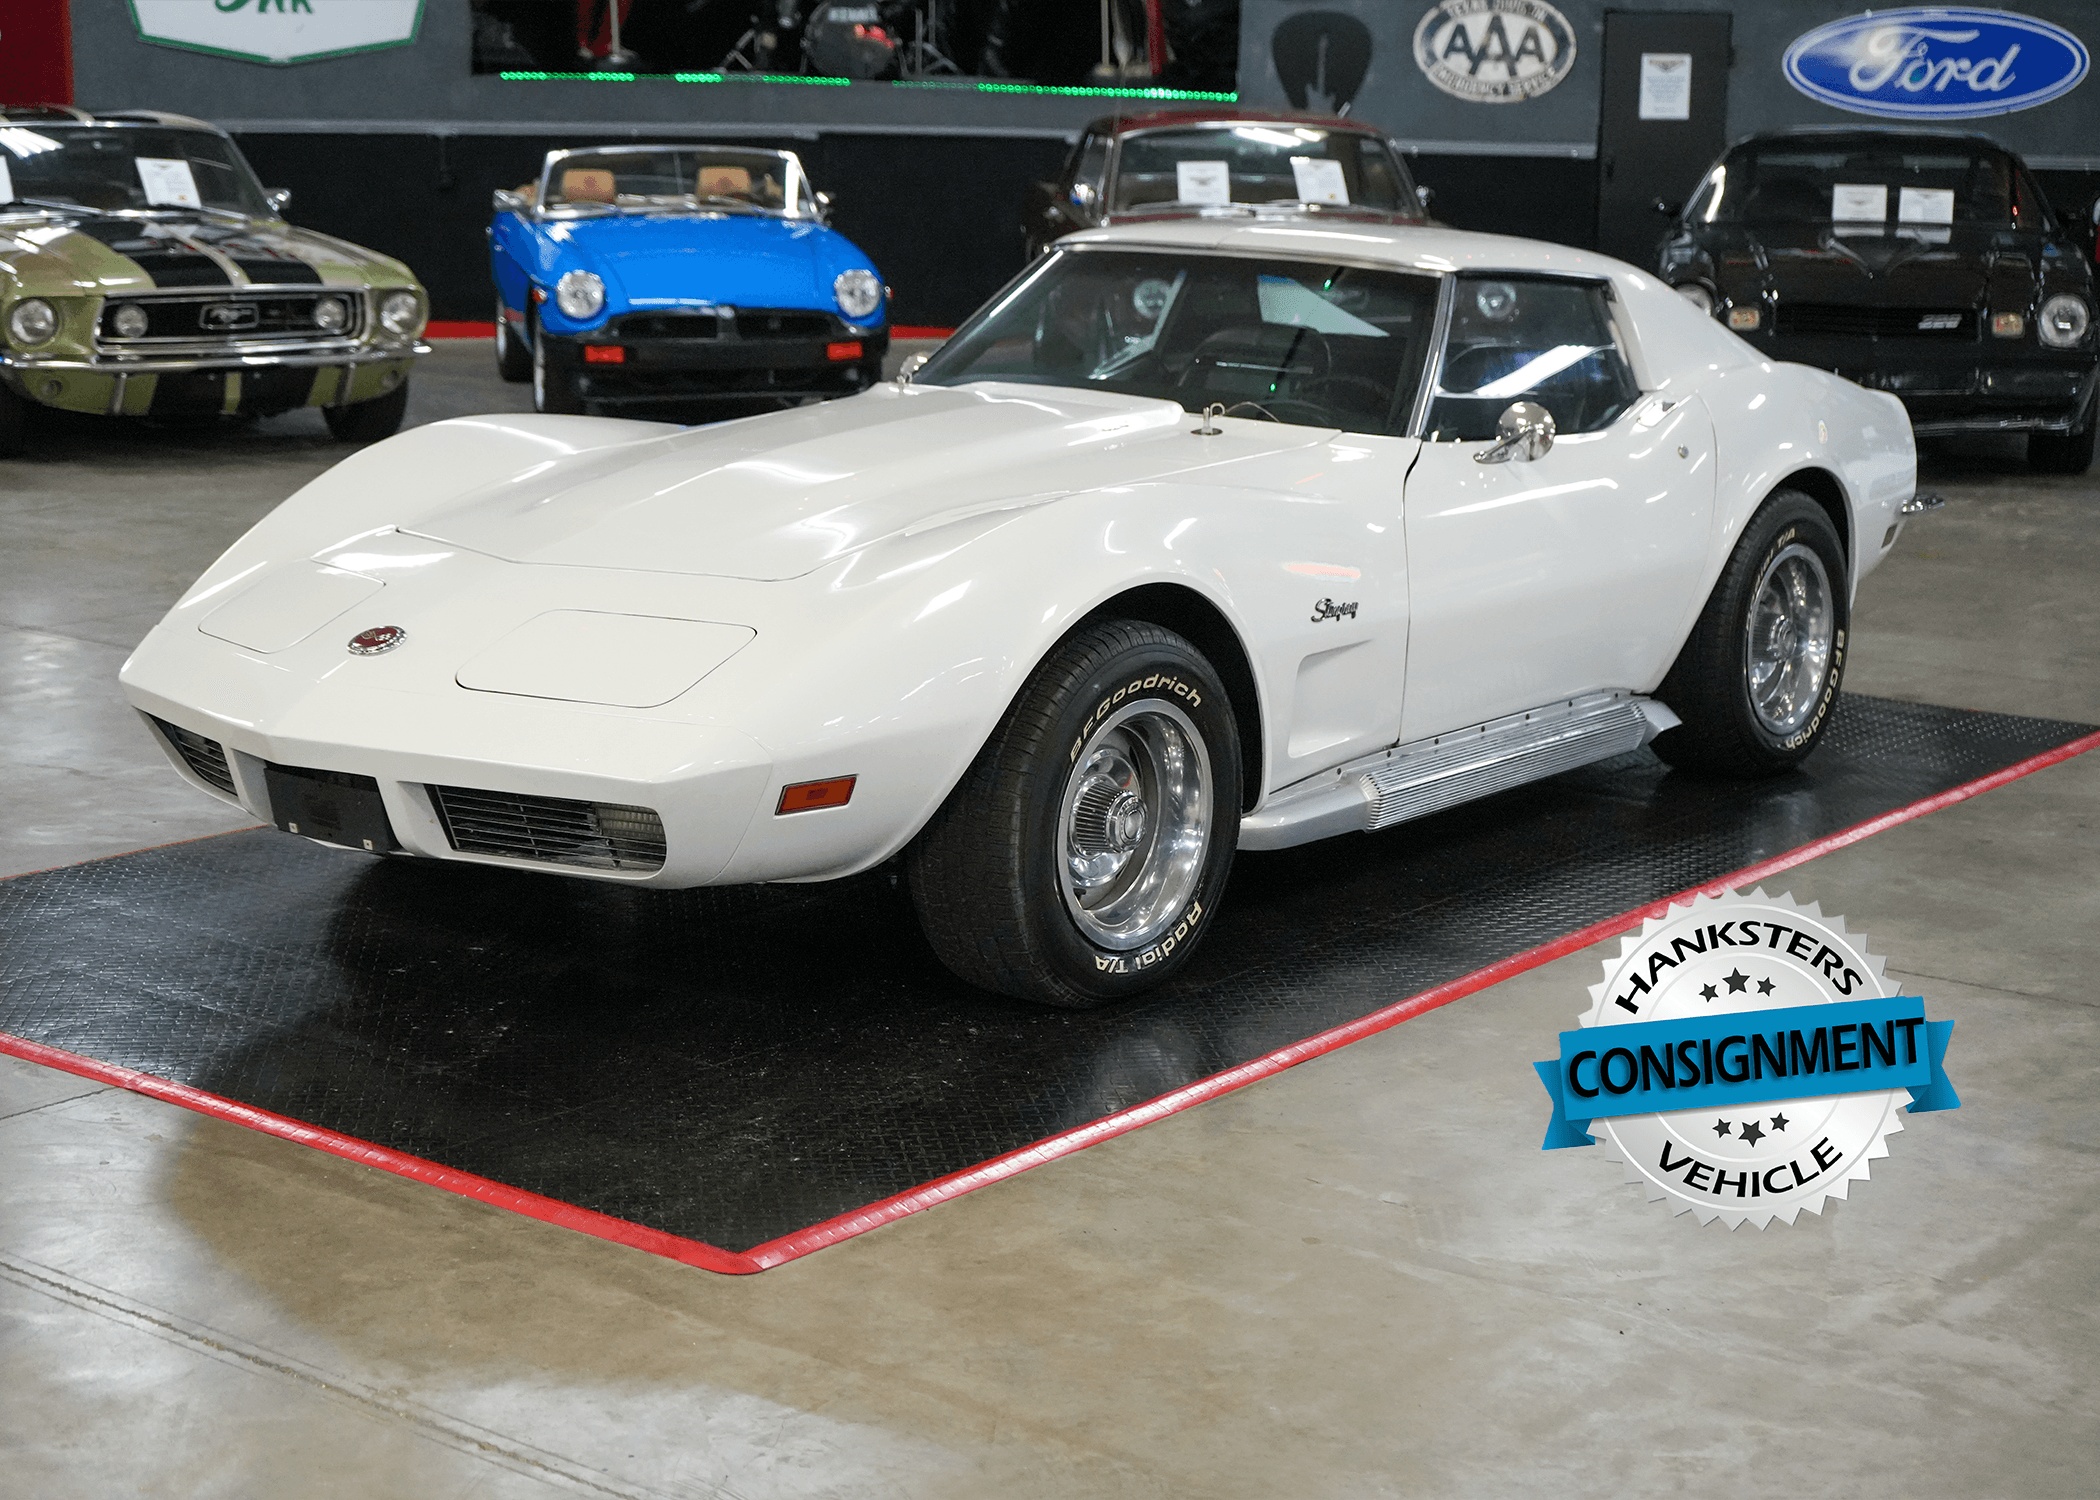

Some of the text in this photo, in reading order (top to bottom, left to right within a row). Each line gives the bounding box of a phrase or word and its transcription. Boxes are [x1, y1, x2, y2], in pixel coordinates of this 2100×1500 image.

[1443, 15, 1545, 76] AAA
[1849, 25, 2021, 92] Ford
[1069, 673, 1202, 763] BFGoodrich
[1785, 629, 1845, 749] BFGoodrich
[1095, 901, 1203, 974] Radial T/A
